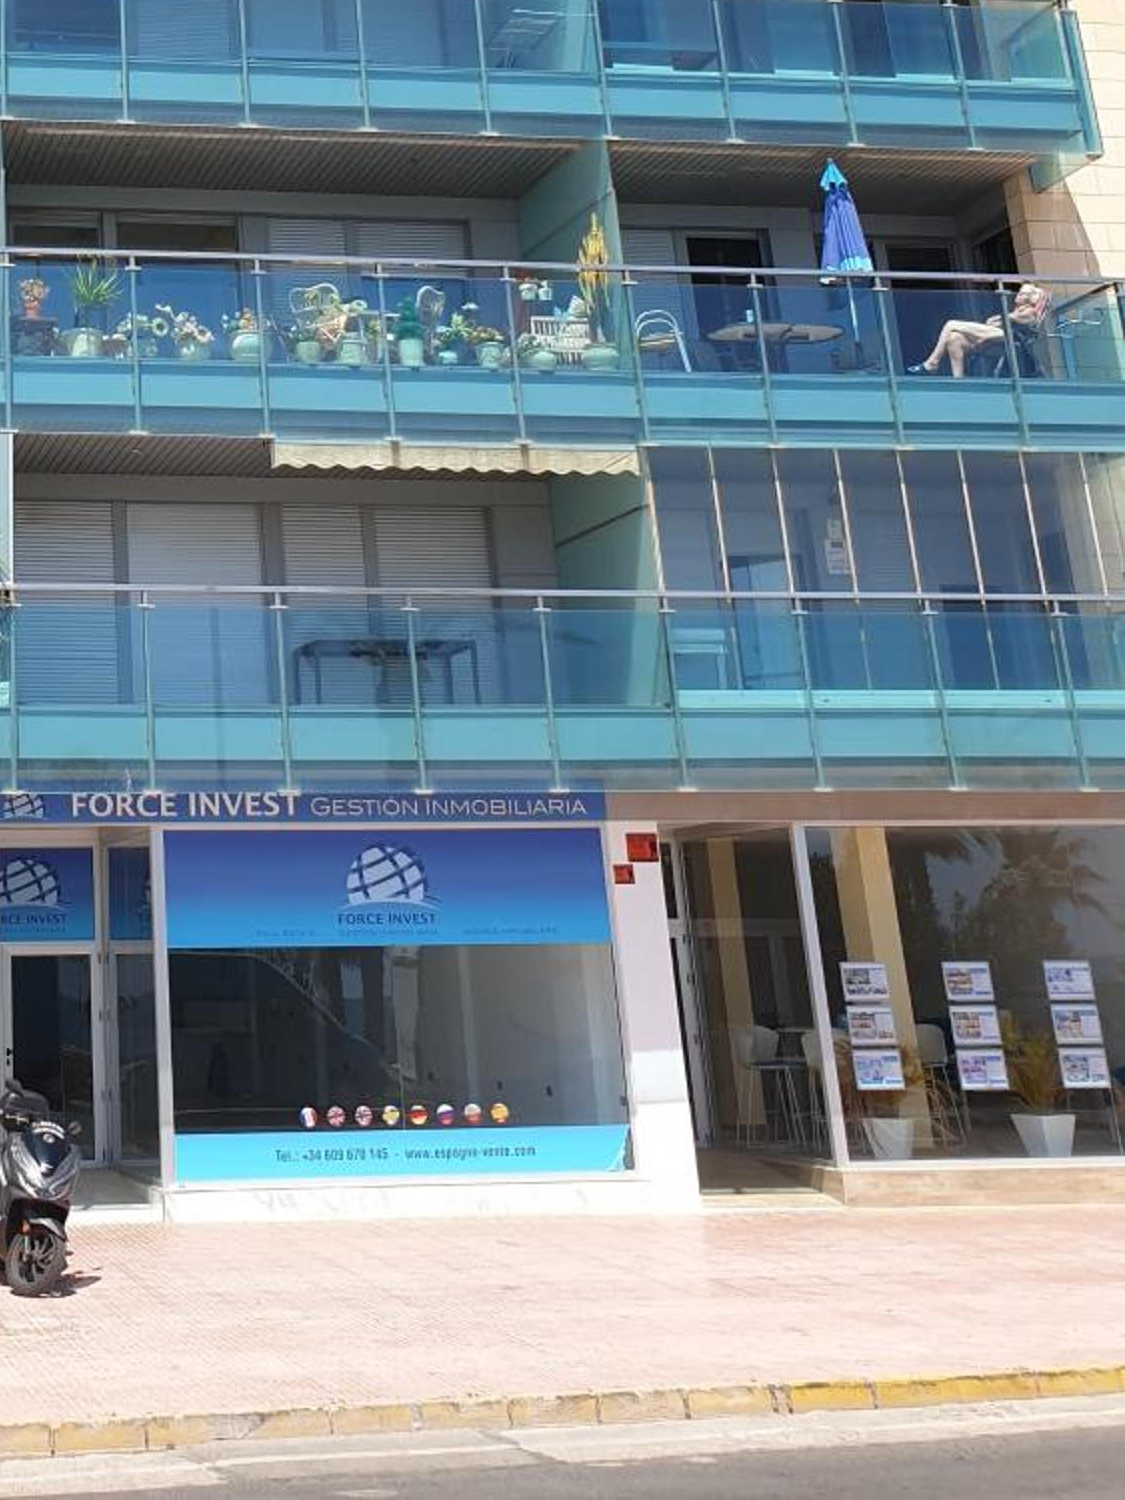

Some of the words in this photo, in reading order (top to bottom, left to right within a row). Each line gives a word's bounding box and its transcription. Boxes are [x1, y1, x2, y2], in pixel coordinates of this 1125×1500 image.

[71, 791, 177, 817] FORCE
[188, 790, 301, 816] INVEST
[425, 798, 587, 815] INMOBILIARIA
[338, 913, 384, 925] FORCE
[389, 912, 436, 924] INVEST
